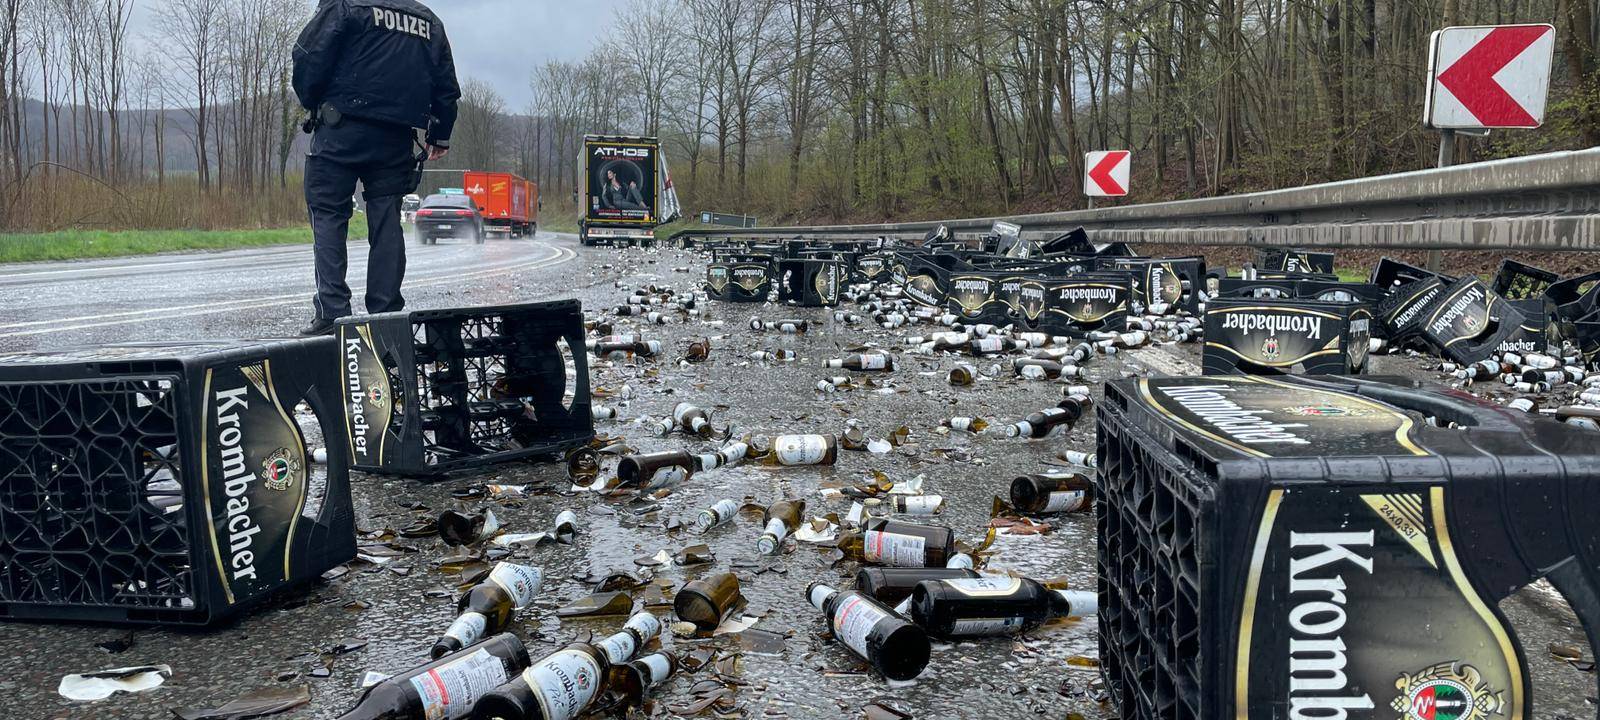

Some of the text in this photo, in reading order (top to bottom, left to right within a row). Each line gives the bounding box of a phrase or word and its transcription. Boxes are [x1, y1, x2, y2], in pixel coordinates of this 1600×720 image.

[372, 7, 431, 40] POLIZEI
[594, 147, 649, 157] ATHOS
[907, 284, 938, 306] Krombacher
[955, 280, 989, 295] Krombacher
[1059, 288, 1116, 303] Krombacher
[1152, 267, 1164, 305] Krombach
[1222, 313, 1321, 340] Krombacher
[1432, 287, 1484, 334] Krombacher
[1496, 338, 1536, 352] bacher
[346, 338, 370, 456] Krombacher
[1158, 384, 1311, 444] Krombacher
[216, 385, 262, 581] Krombacher
[506, 564, 533, 597] mbacher
[1288, 529, 1375, 720] Kromb
[544, 661, 578, 717] Krombach
